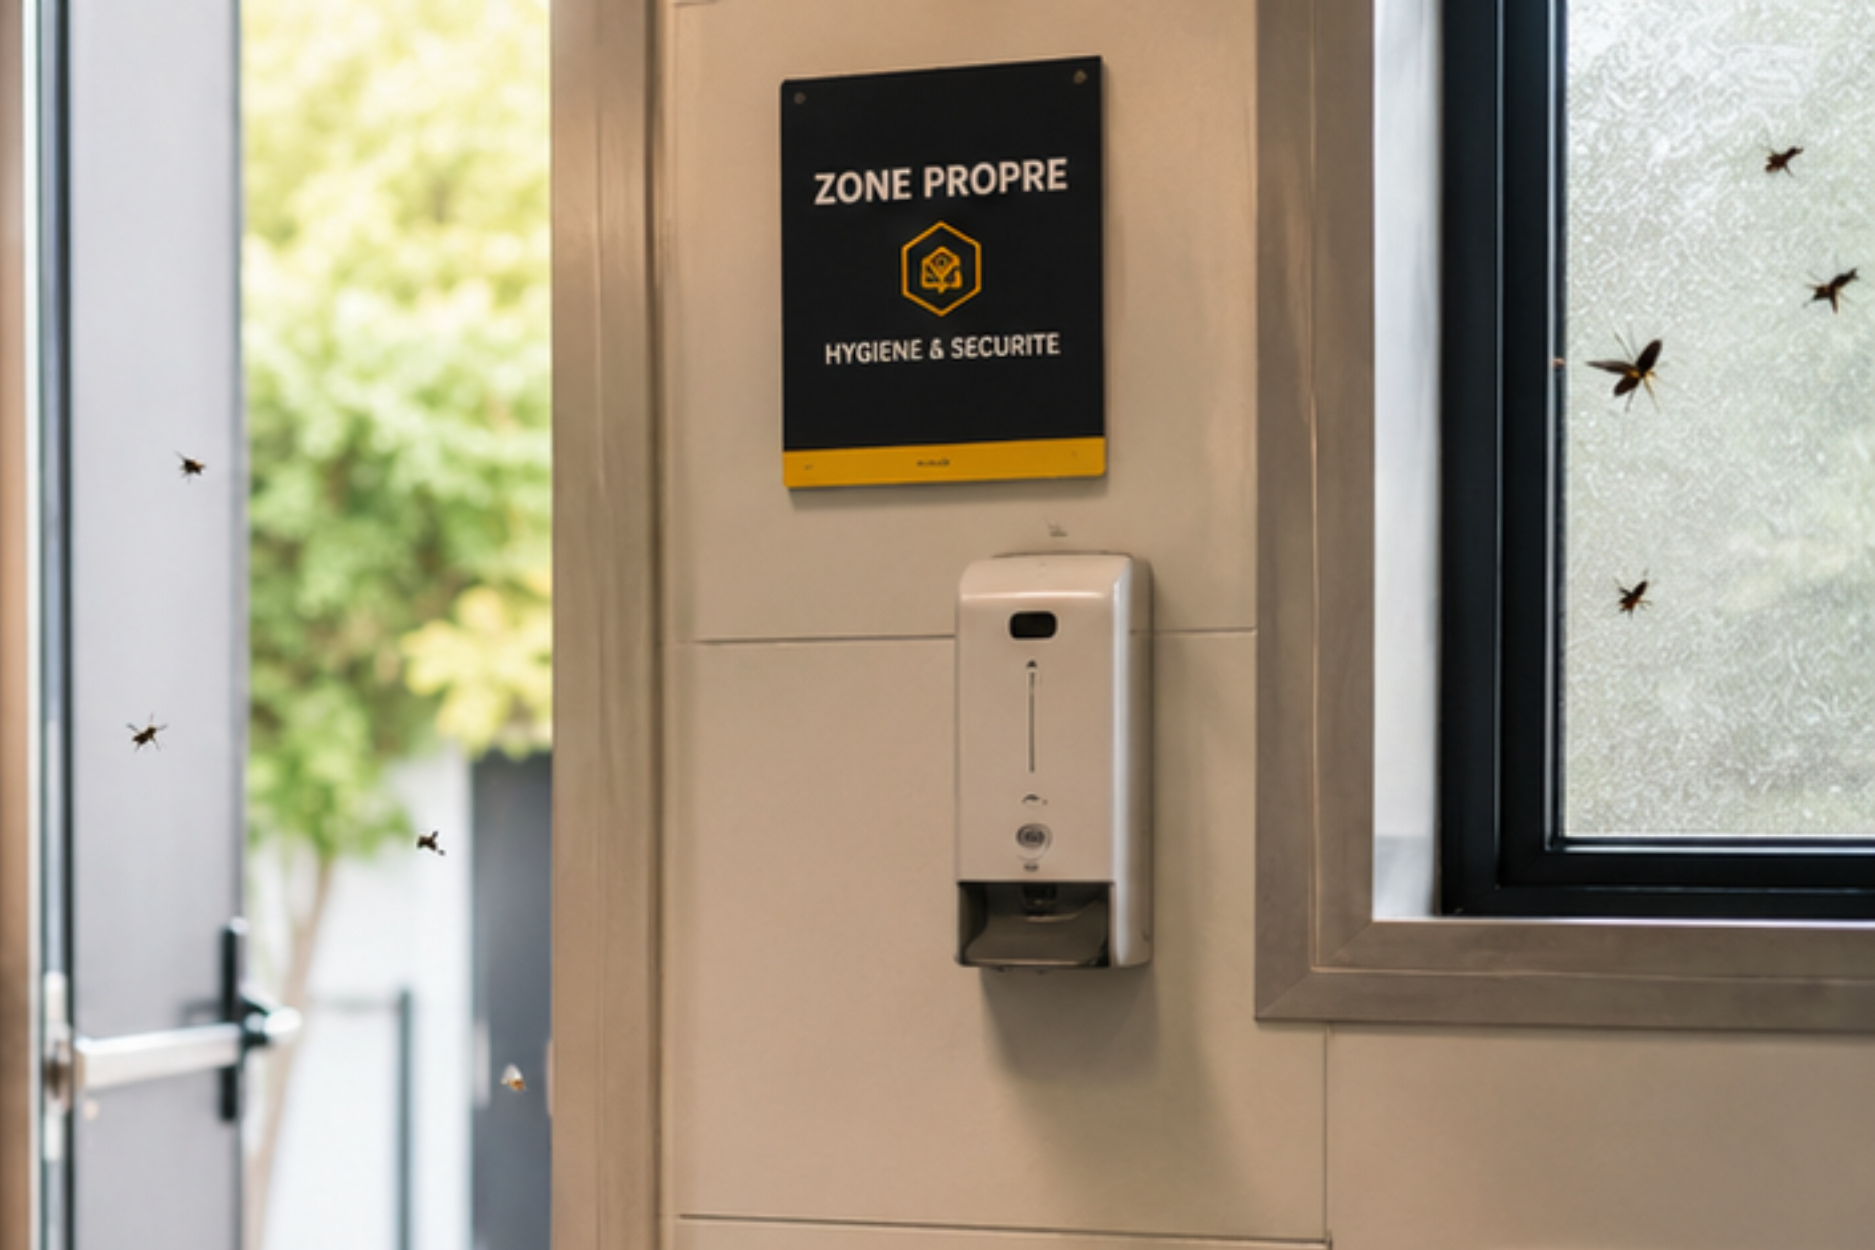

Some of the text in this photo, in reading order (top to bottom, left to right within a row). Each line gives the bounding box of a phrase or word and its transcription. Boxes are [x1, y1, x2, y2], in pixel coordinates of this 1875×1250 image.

[814, 157, 1068, 205] ZONE PROPRE
[825, 332, 1060, 365] HYGIENE & SECURITE
